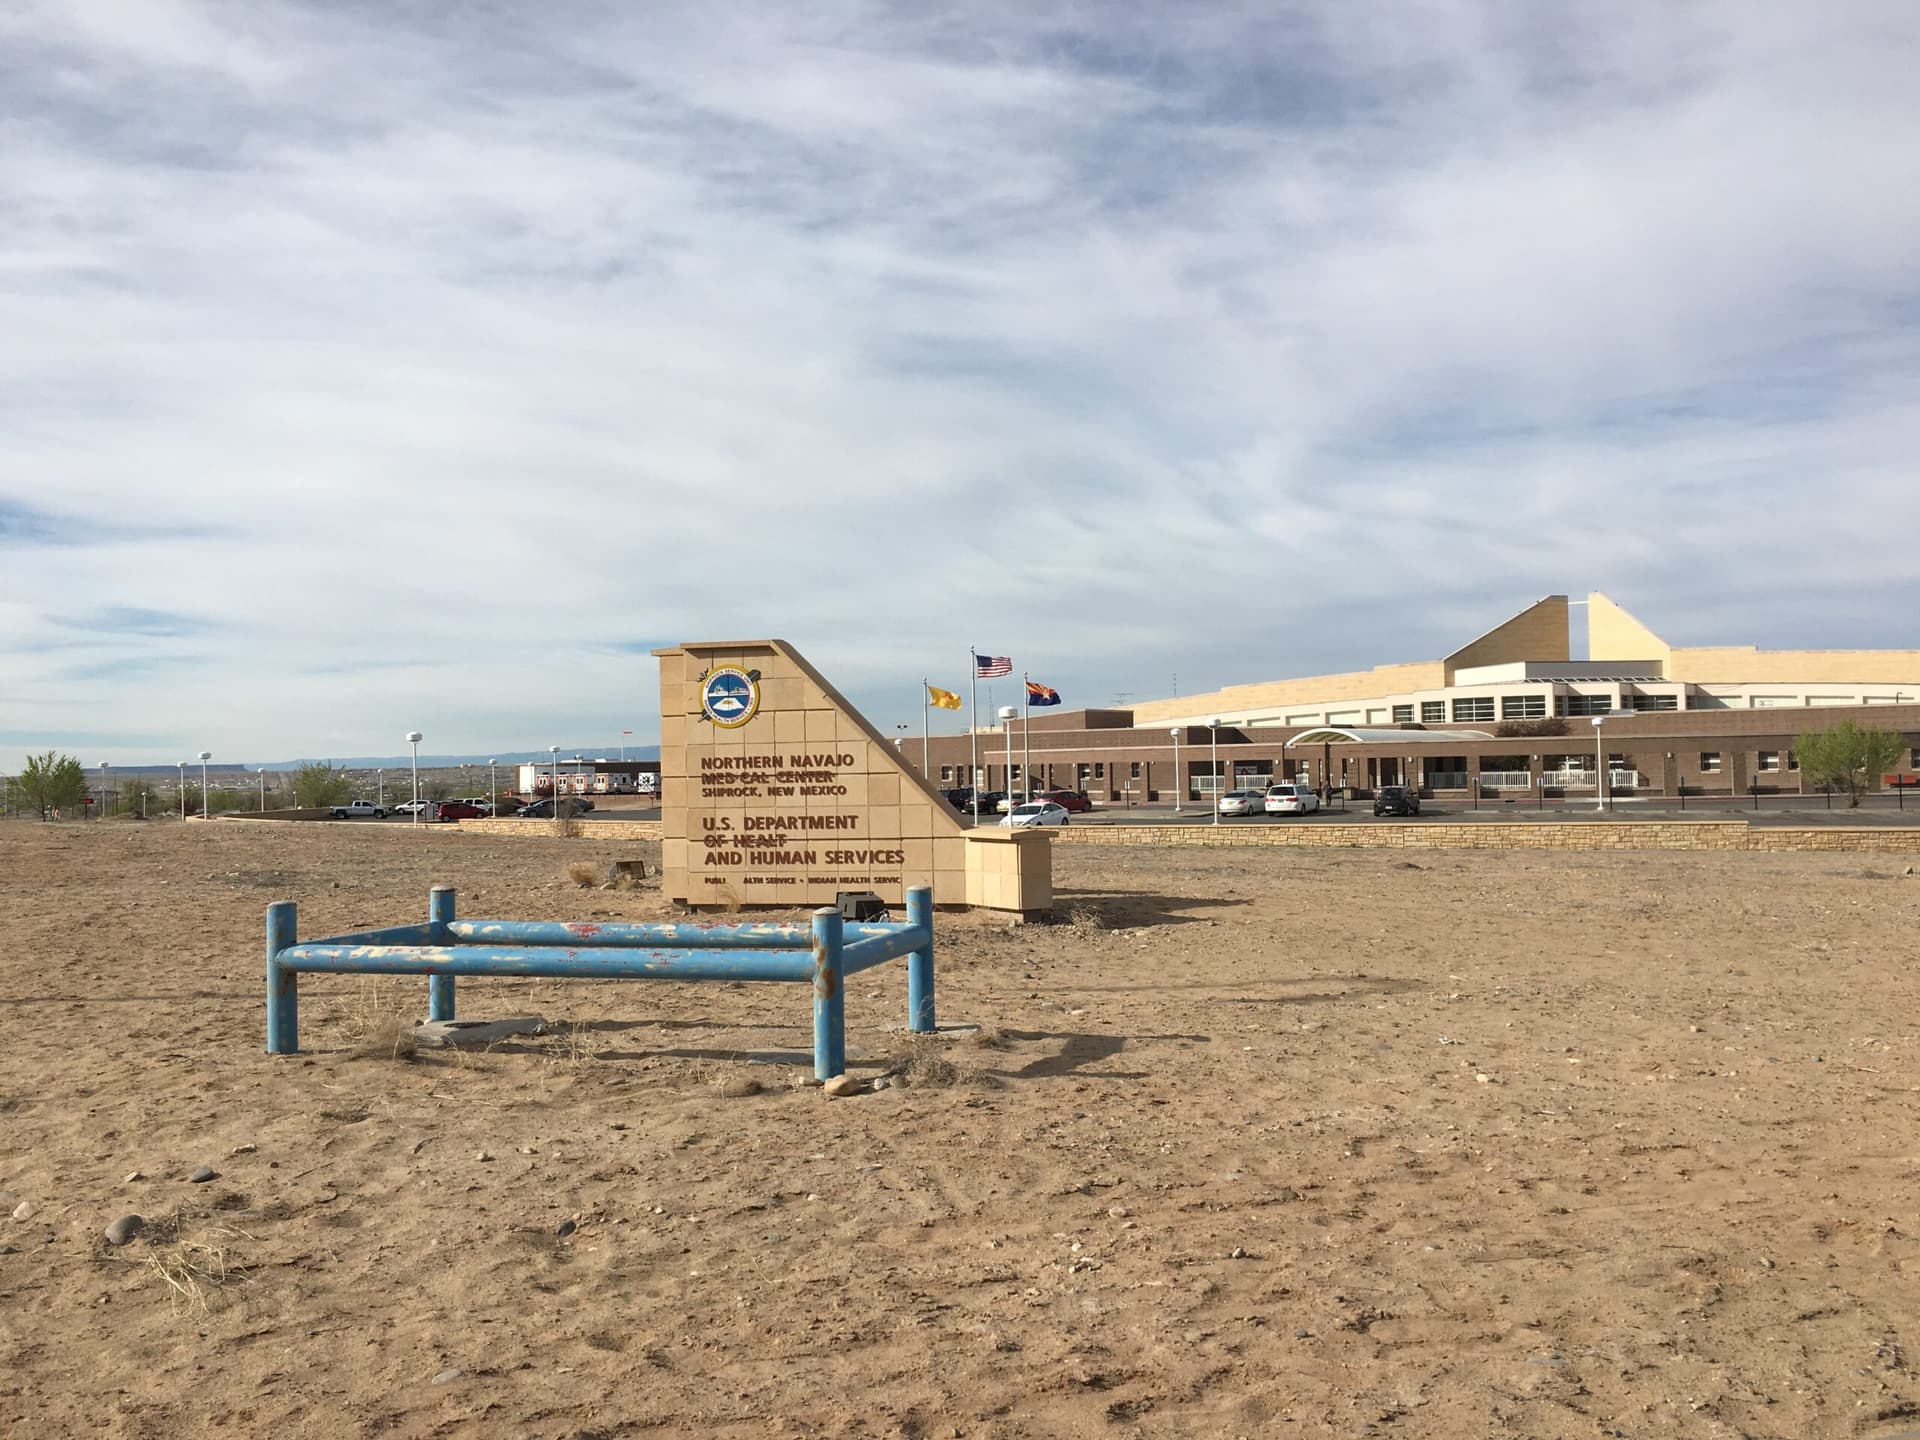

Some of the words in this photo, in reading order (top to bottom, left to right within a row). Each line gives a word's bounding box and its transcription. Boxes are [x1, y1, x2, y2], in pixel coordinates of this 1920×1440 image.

[701, 756, 783, 769] NORTHERN
[790, 754, 854, 767] NAVAJO
[776, 770, 833, 783] CENTER
[702, 787, 762, 797] SHIPROCK,
[767, 786, 794, 796] NEW
[800, 785, 847, 796] MEXICO
[703, 817, 735, 831] U.S.
[743, 815, 858, 830] DEPARTMENT
[703, 834, 727, 848] OF
[704, 851, 742, 865] AND
[750, 851, 816, 865] HUMAN
[824, 850, 905, 864] SERVICES
